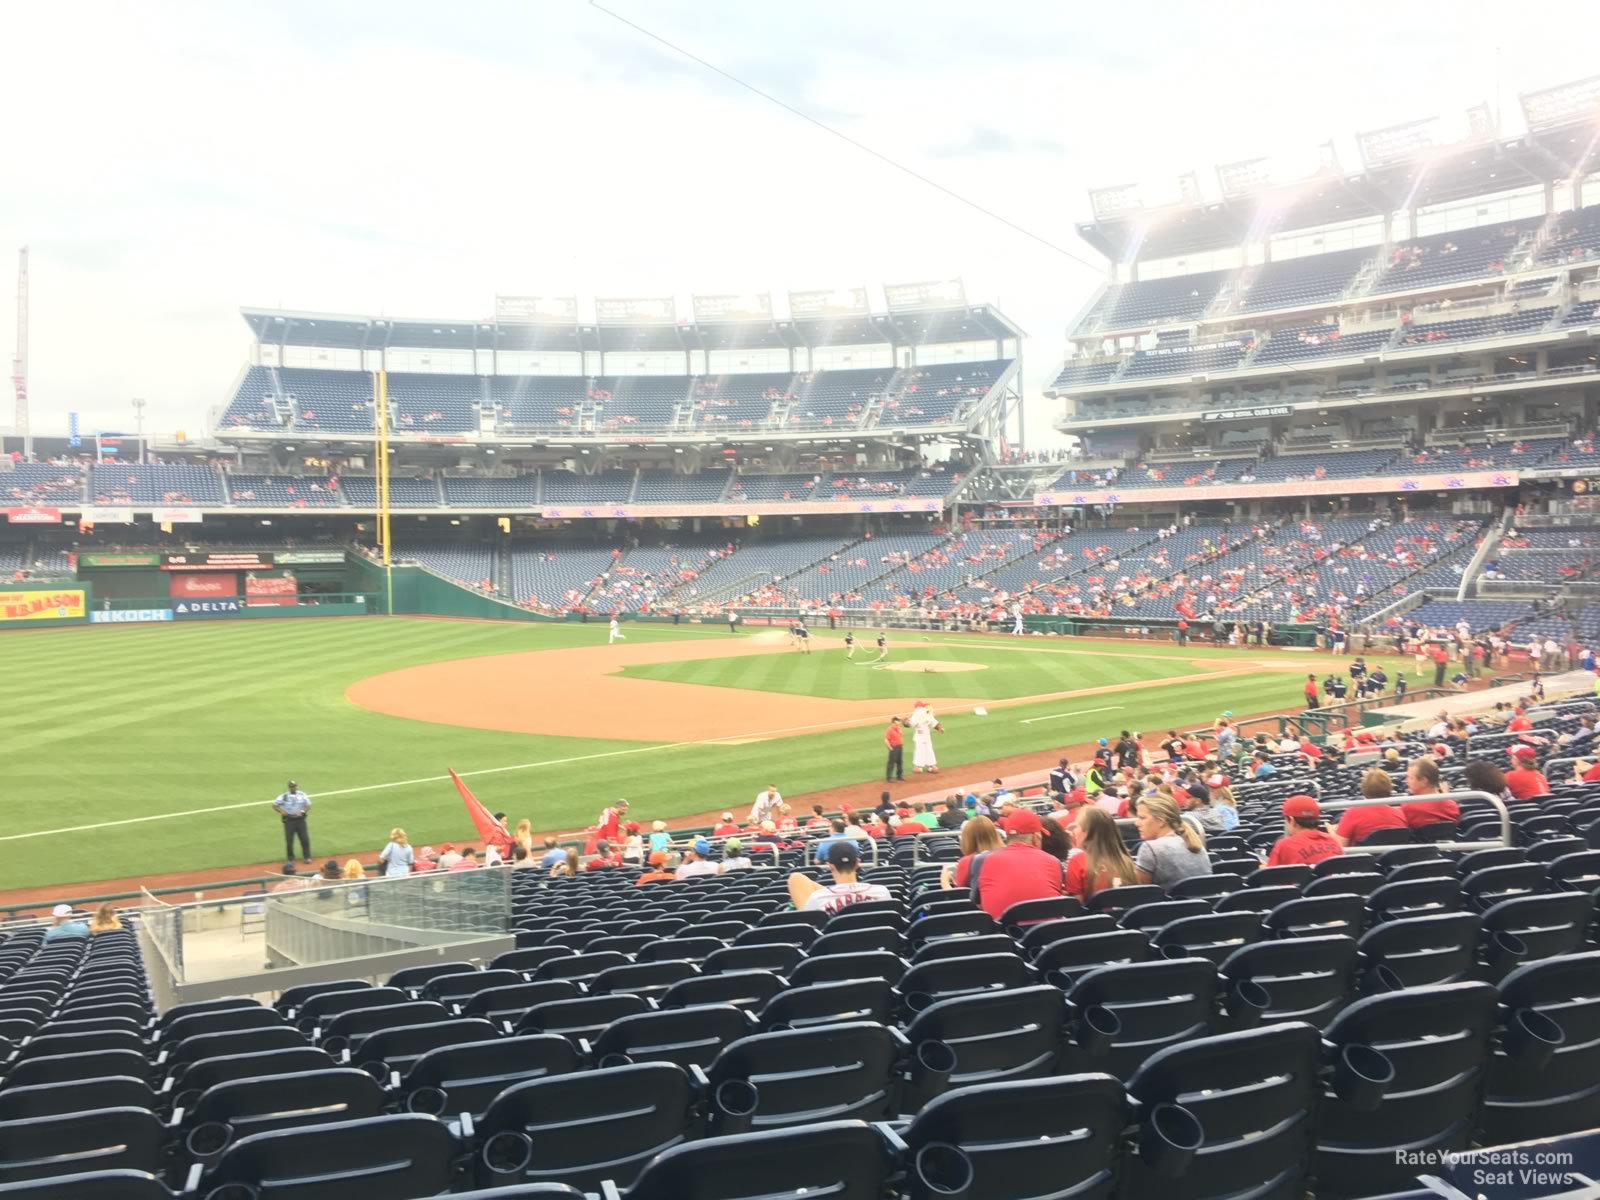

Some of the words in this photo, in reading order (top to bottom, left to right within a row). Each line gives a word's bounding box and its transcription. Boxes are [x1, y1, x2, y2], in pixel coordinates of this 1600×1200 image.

[1254, 408, 1270, 416] CLUB
[1270, 407, 1289, 415] LEVEL
[190, 602, 238, 612] DELTA
[112, 609, 163, 623] KOCH
